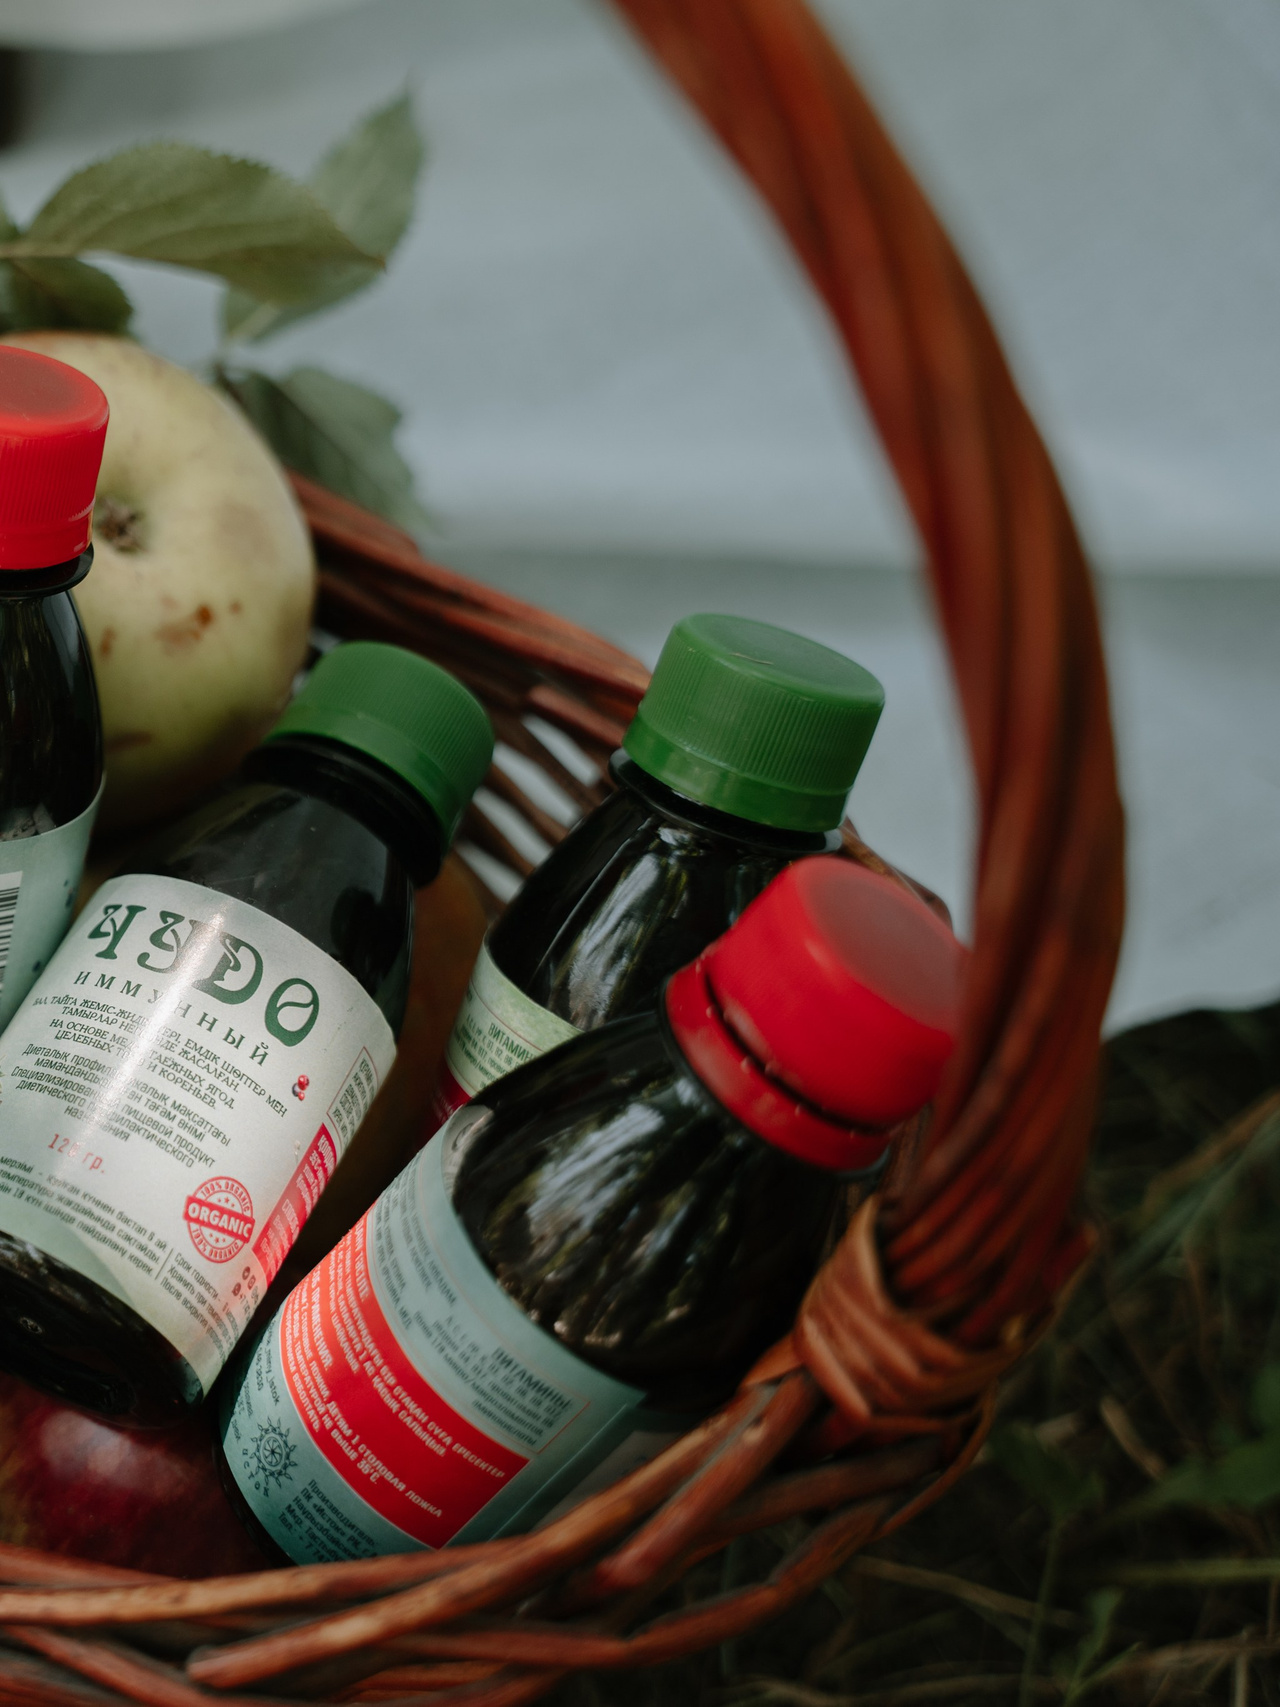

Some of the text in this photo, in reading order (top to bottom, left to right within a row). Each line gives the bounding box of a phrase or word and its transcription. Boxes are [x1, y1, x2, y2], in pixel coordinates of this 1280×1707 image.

[49, 1018, 64, 1029] НА
[66, 1021, 110, 1041] ОСНОВЕ
[61, 1006, 118, 1026] ТАМЫРЛАР
[54, 1029, 115, 1053] ЦЕЛЕБНЫХ
[147, 1061, 158, 1073] И
[488, 1022, 533, 1062] ВИТАМИН
[15, 1079, 87, 1108] диетического
[221, 1060, 267, 1098] ШӨПТЕР
[265, 1094, 288, 1118] МЕН
[121, 1104, 173, 1137] пищевой
[173, 1134, 216, 1168] продукт
[224, 1181, 250, 1213] ORGANIC
[115, 1211, 148, 1238] бастап
[188, 1202, 252, 1238] ORGANIC
[167, 1263, 195, 1295] Хранить
[194, 1291, 207, 1308] при
[174, 1252, 192, 1274] Срок
[191, 1269, 219, 1301] годности
[160, 1276, 183, 1301] После
[181, 1296, 209, 1328] вскрытия
[311, 1286, 334, 1371] ПРИМЕНЕНИЯ:
[292, 1371, 320, 1433] ВЗБОЛТАТЬ.
[294, 1339, 328, 1415] ТЕМПЕРАТУРОЙ
[322, 1413, 334, 1430] НЕ
[331, 1428, 359, 1461] ВЫШЕ
[301, 1311, 314, 1361] СТОЛОВЫЕ
[309, 1360, 330, 1401] ЛОЖКИ,
[326, 1400, 353, 1437] ДЕТЯМ
[358, 1443, 407, 1492] СТОЛОВАЯ
[404, 1490, 443, 1519] ЛОЖКА
[300, 1487, 314, 1503] ПК
